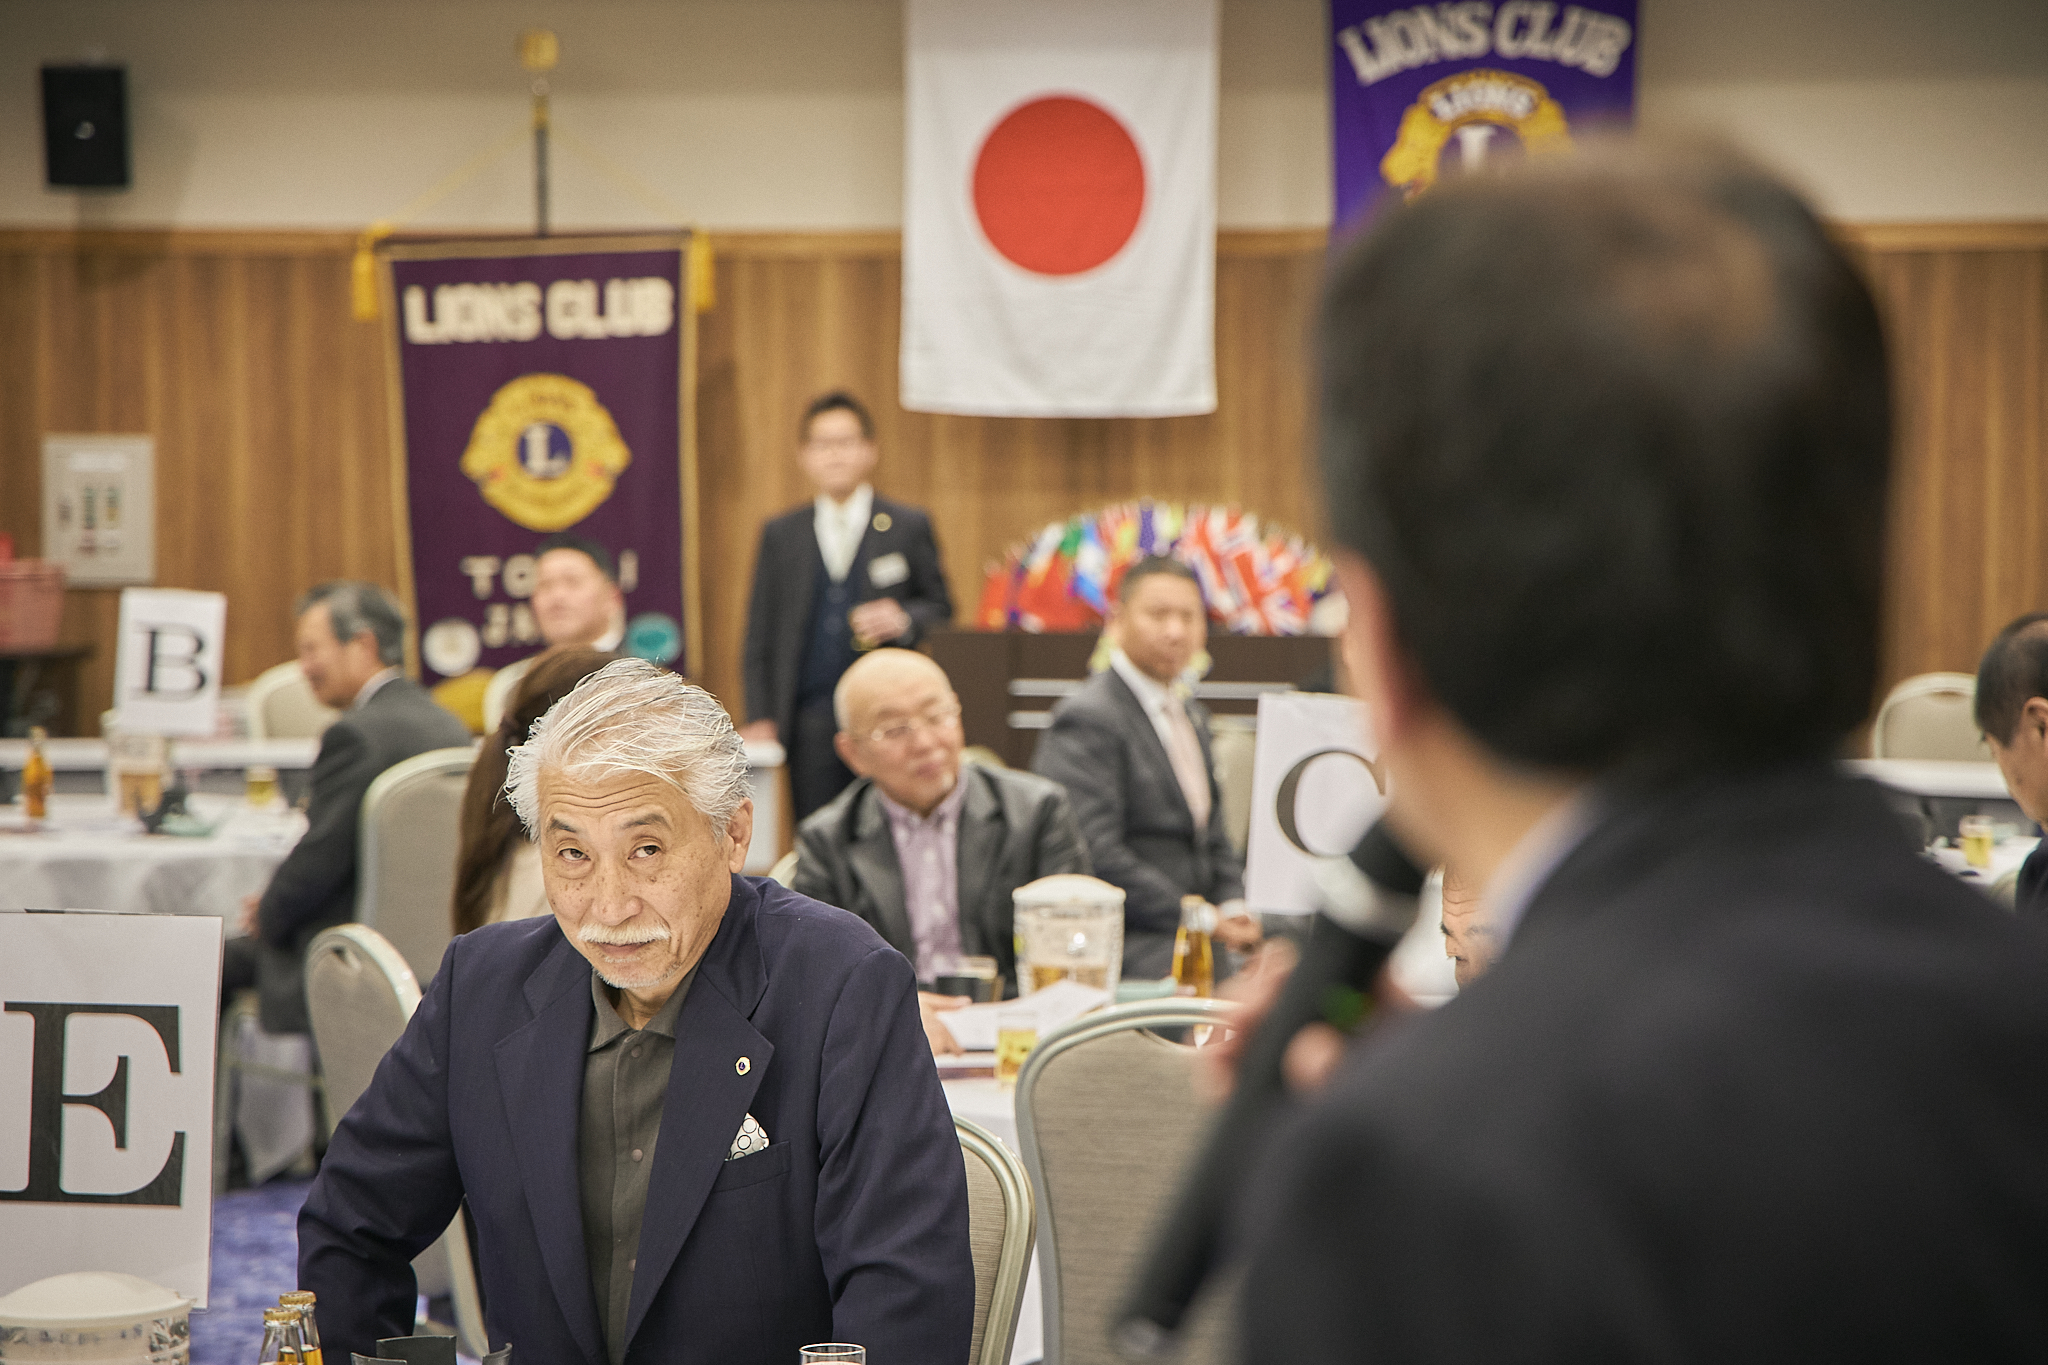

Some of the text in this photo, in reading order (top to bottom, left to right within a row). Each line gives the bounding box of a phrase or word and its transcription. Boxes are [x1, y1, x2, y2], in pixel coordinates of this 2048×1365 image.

[1339, 1, 1632, 87] LIONS CLUB
[403, 276, 675, 345] LIONS CLUB
[519, 420, 571, 480] L
[132, 620, 208, 700] B
[1275, 748, 1388, 859] C
[0, 1001, 186, 1208] E
